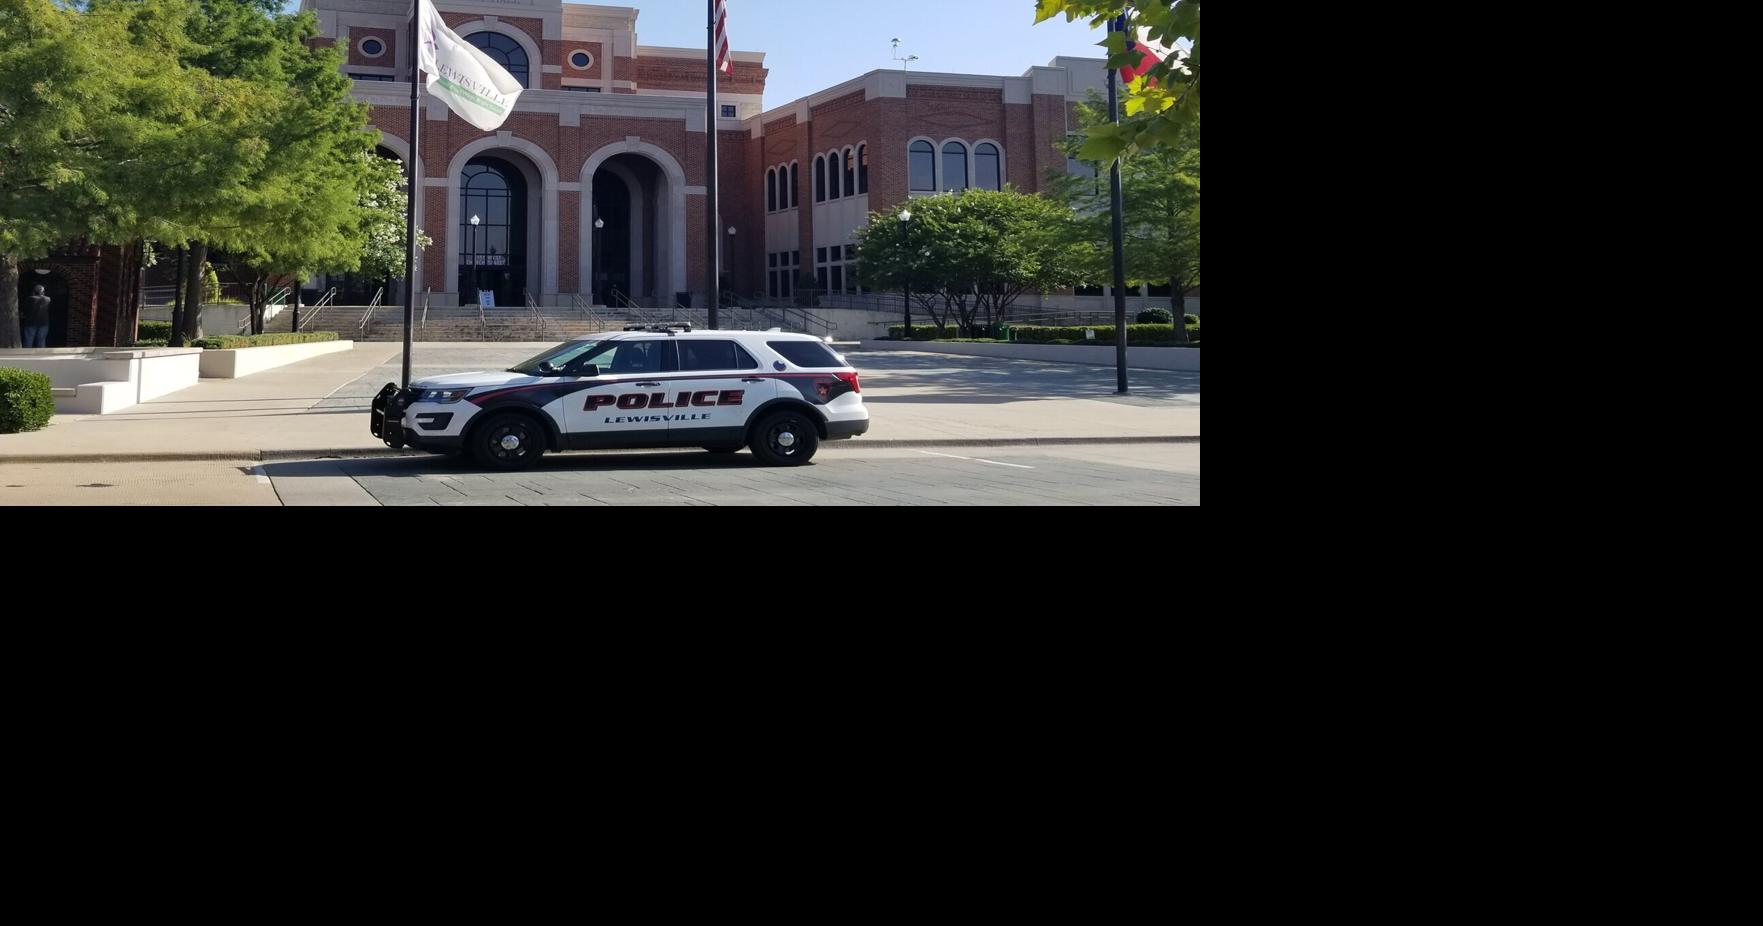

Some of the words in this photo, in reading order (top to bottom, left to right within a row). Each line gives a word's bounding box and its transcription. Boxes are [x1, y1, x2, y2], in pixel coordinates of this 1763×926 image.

[435, 59, 508, 108] LEWISVILLE
[583, 389, 745, 412] POLICE
[604, 413, 711, 424] LEWISVILLE
